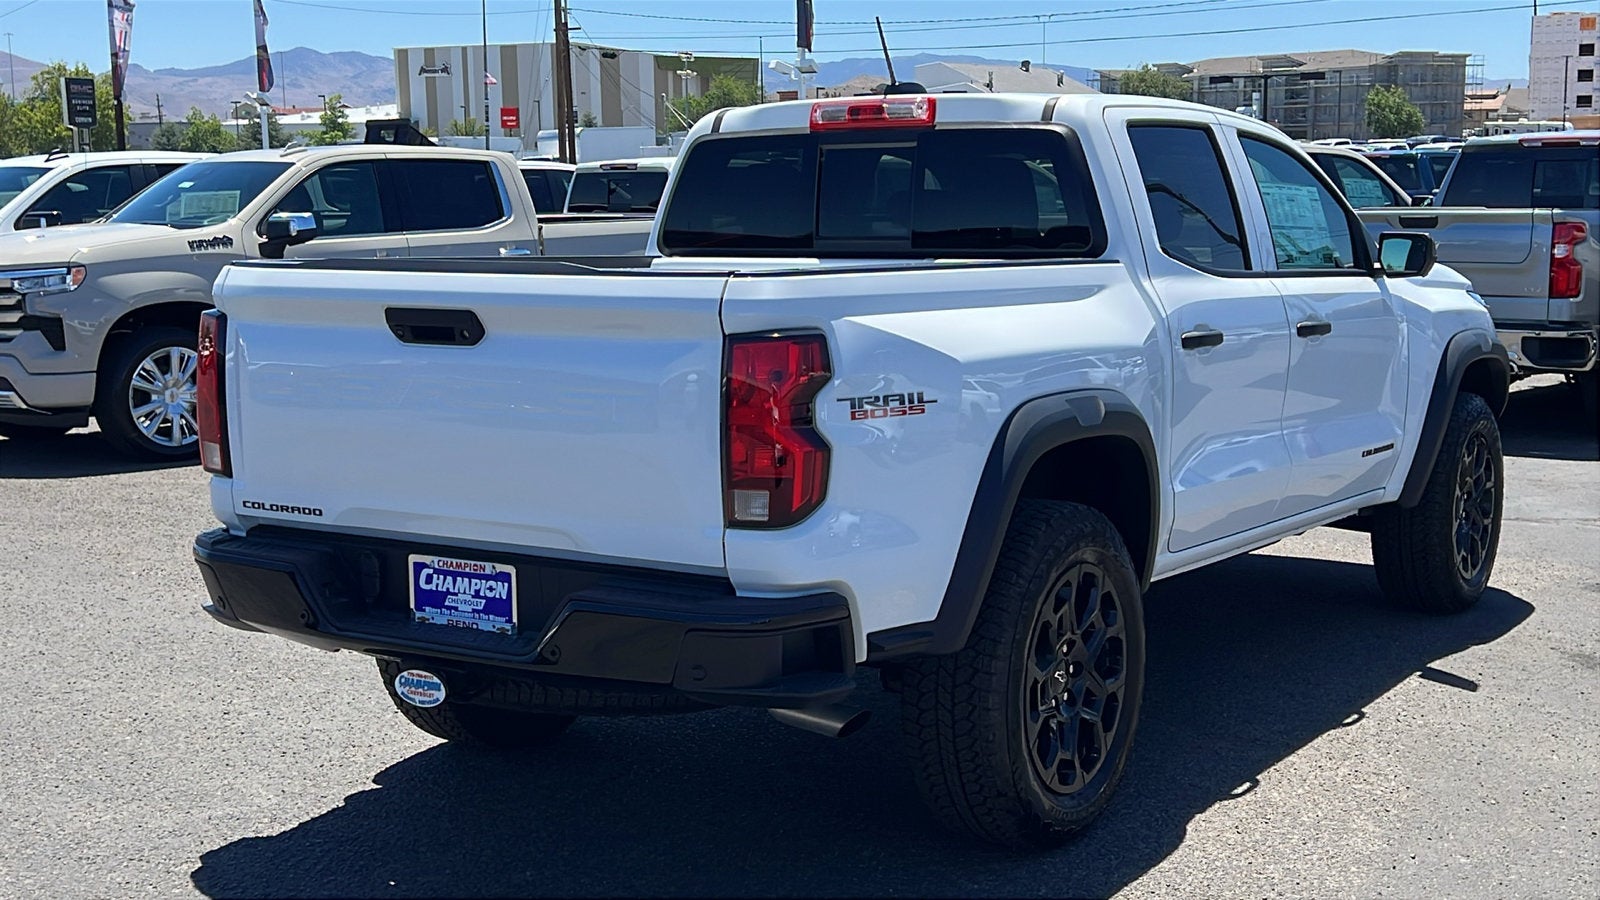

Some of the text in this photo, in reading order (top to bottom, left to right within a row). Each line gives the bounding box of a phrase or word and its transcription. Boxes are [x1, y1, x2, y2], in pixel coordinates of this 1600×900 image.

[836, 391, 938, 410] TRAIL
[850, 404, 926, 421] BOSS
[242, 500, 323, 517] COLORADO
[437, 559, 486, 573] CHAMPION
[419, 568, 509, 600] CHAMPION
[447, 597, 483, 608] CHEVROLET
[447, 619, 479, 629] RENO
[407, 689, 435, 698] CHEVROLET
